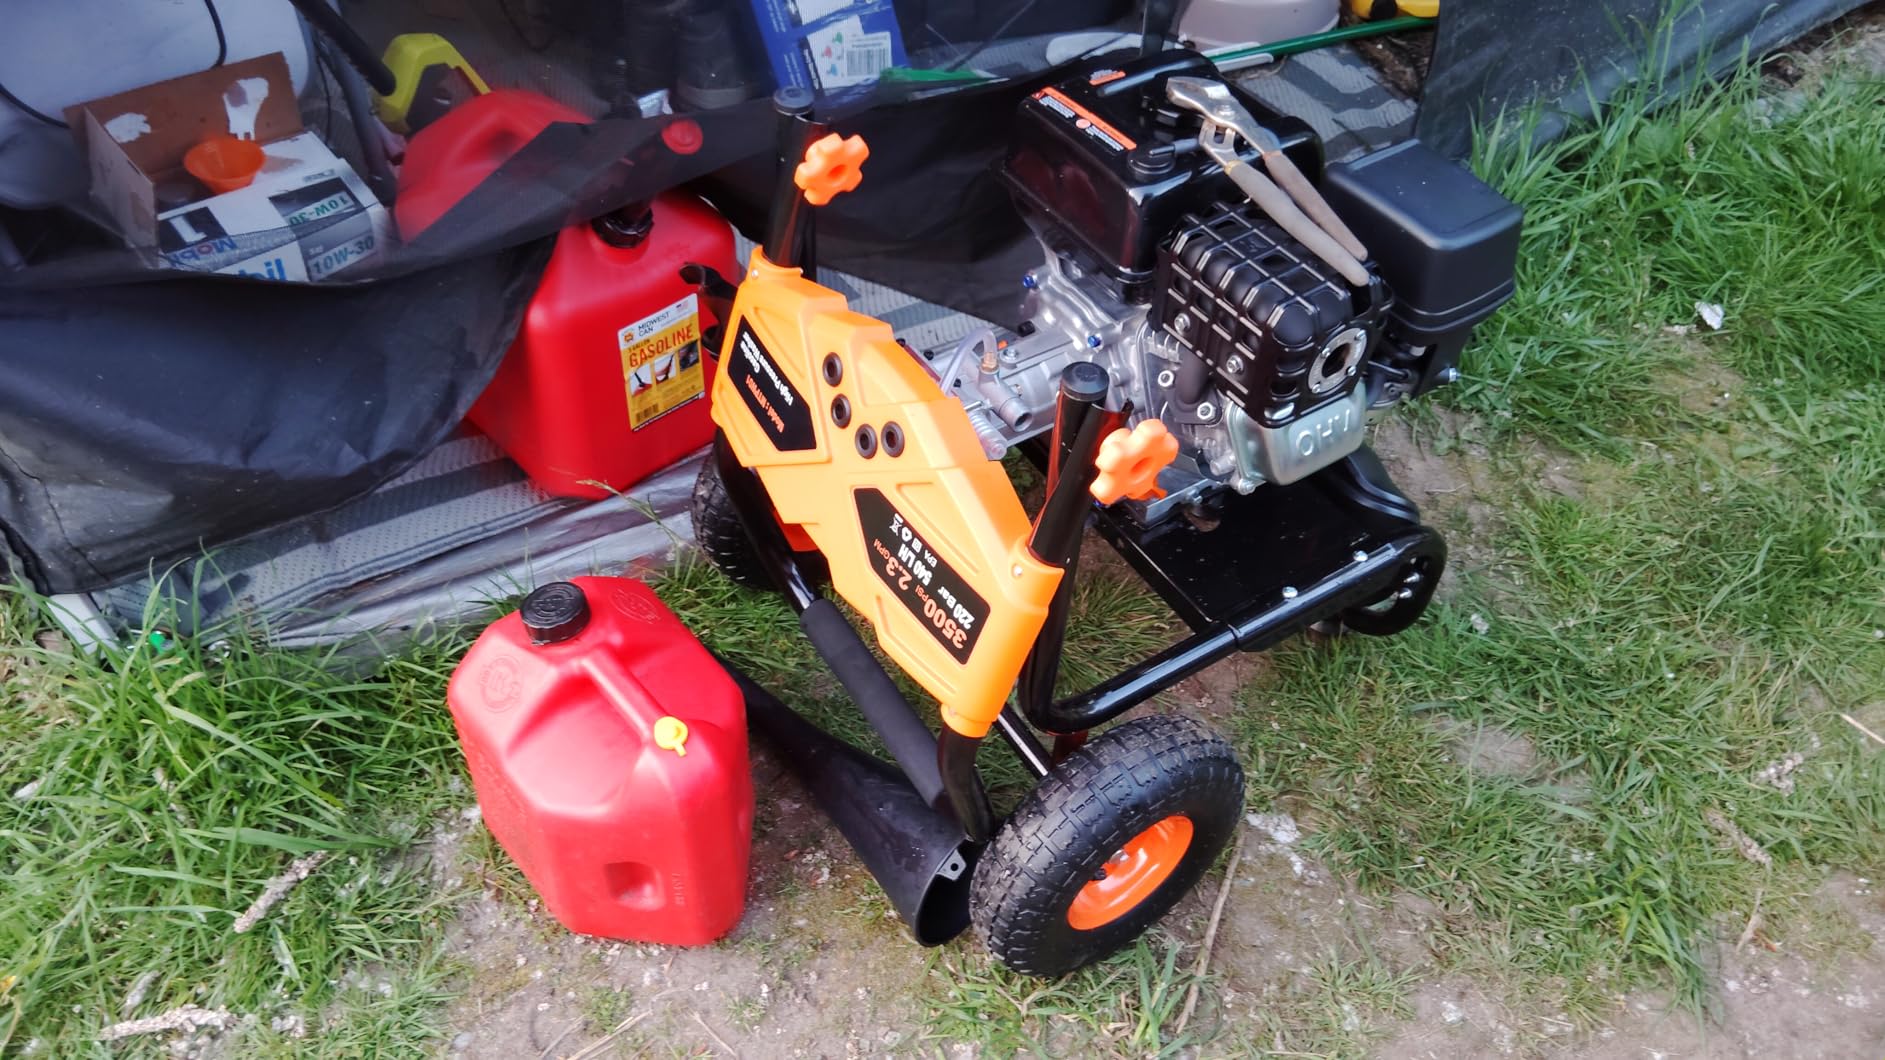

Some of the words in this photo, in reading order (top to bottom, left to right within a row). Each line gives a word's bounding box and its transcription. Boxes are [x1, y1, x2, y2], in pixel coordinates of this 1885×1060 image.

[312, 235, 375, 275] 10W-30
[637, 311, 670, 331] MIDWEST
[638, 327, 654, 338] CAN
[628, 322, 694, 367] GASOLINE
[759, 354, 781, 390] Pressure
[780, 382, 794, 406] High
[924, 549, 938, 568] EPA
[913, 560, 933, 586] 540
[938, 586, 957, 609] Bar
[953, 603, 975, 630] 220
